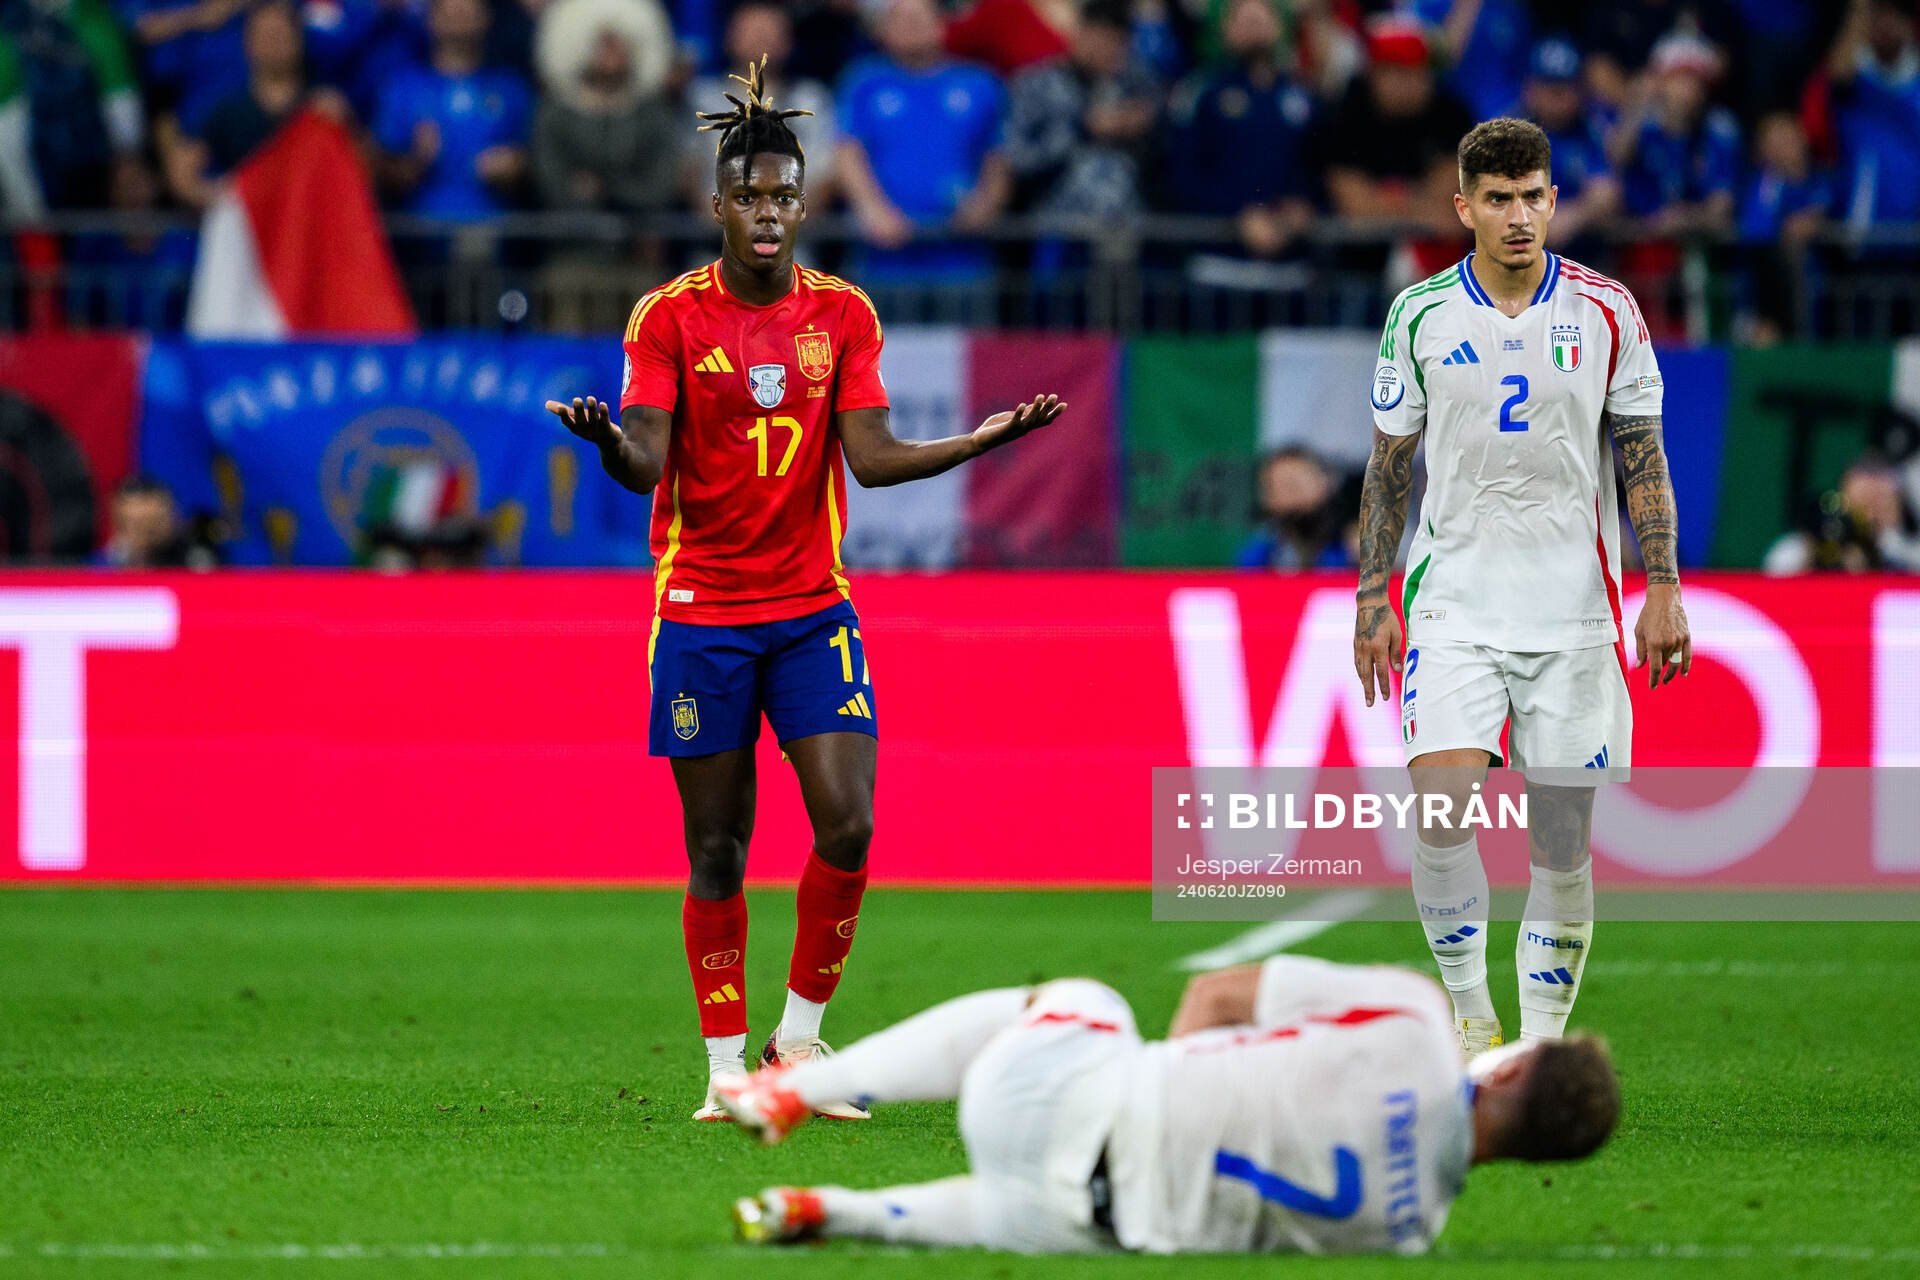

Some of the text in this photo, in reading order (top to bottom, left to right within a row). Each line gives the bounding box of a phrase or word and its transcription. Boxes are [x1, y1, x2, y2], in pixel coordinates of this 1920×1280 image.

[1500, 375, 1530, 432] 2
[747, 416, 803, 476] 17
[1403, 648, 1419, 707] 2
[1421, 896, 1477, 917] ITALIA
[1528, 931, 1584, 949] ITALIA
[1215, 1146, 1362, 1221] 7
